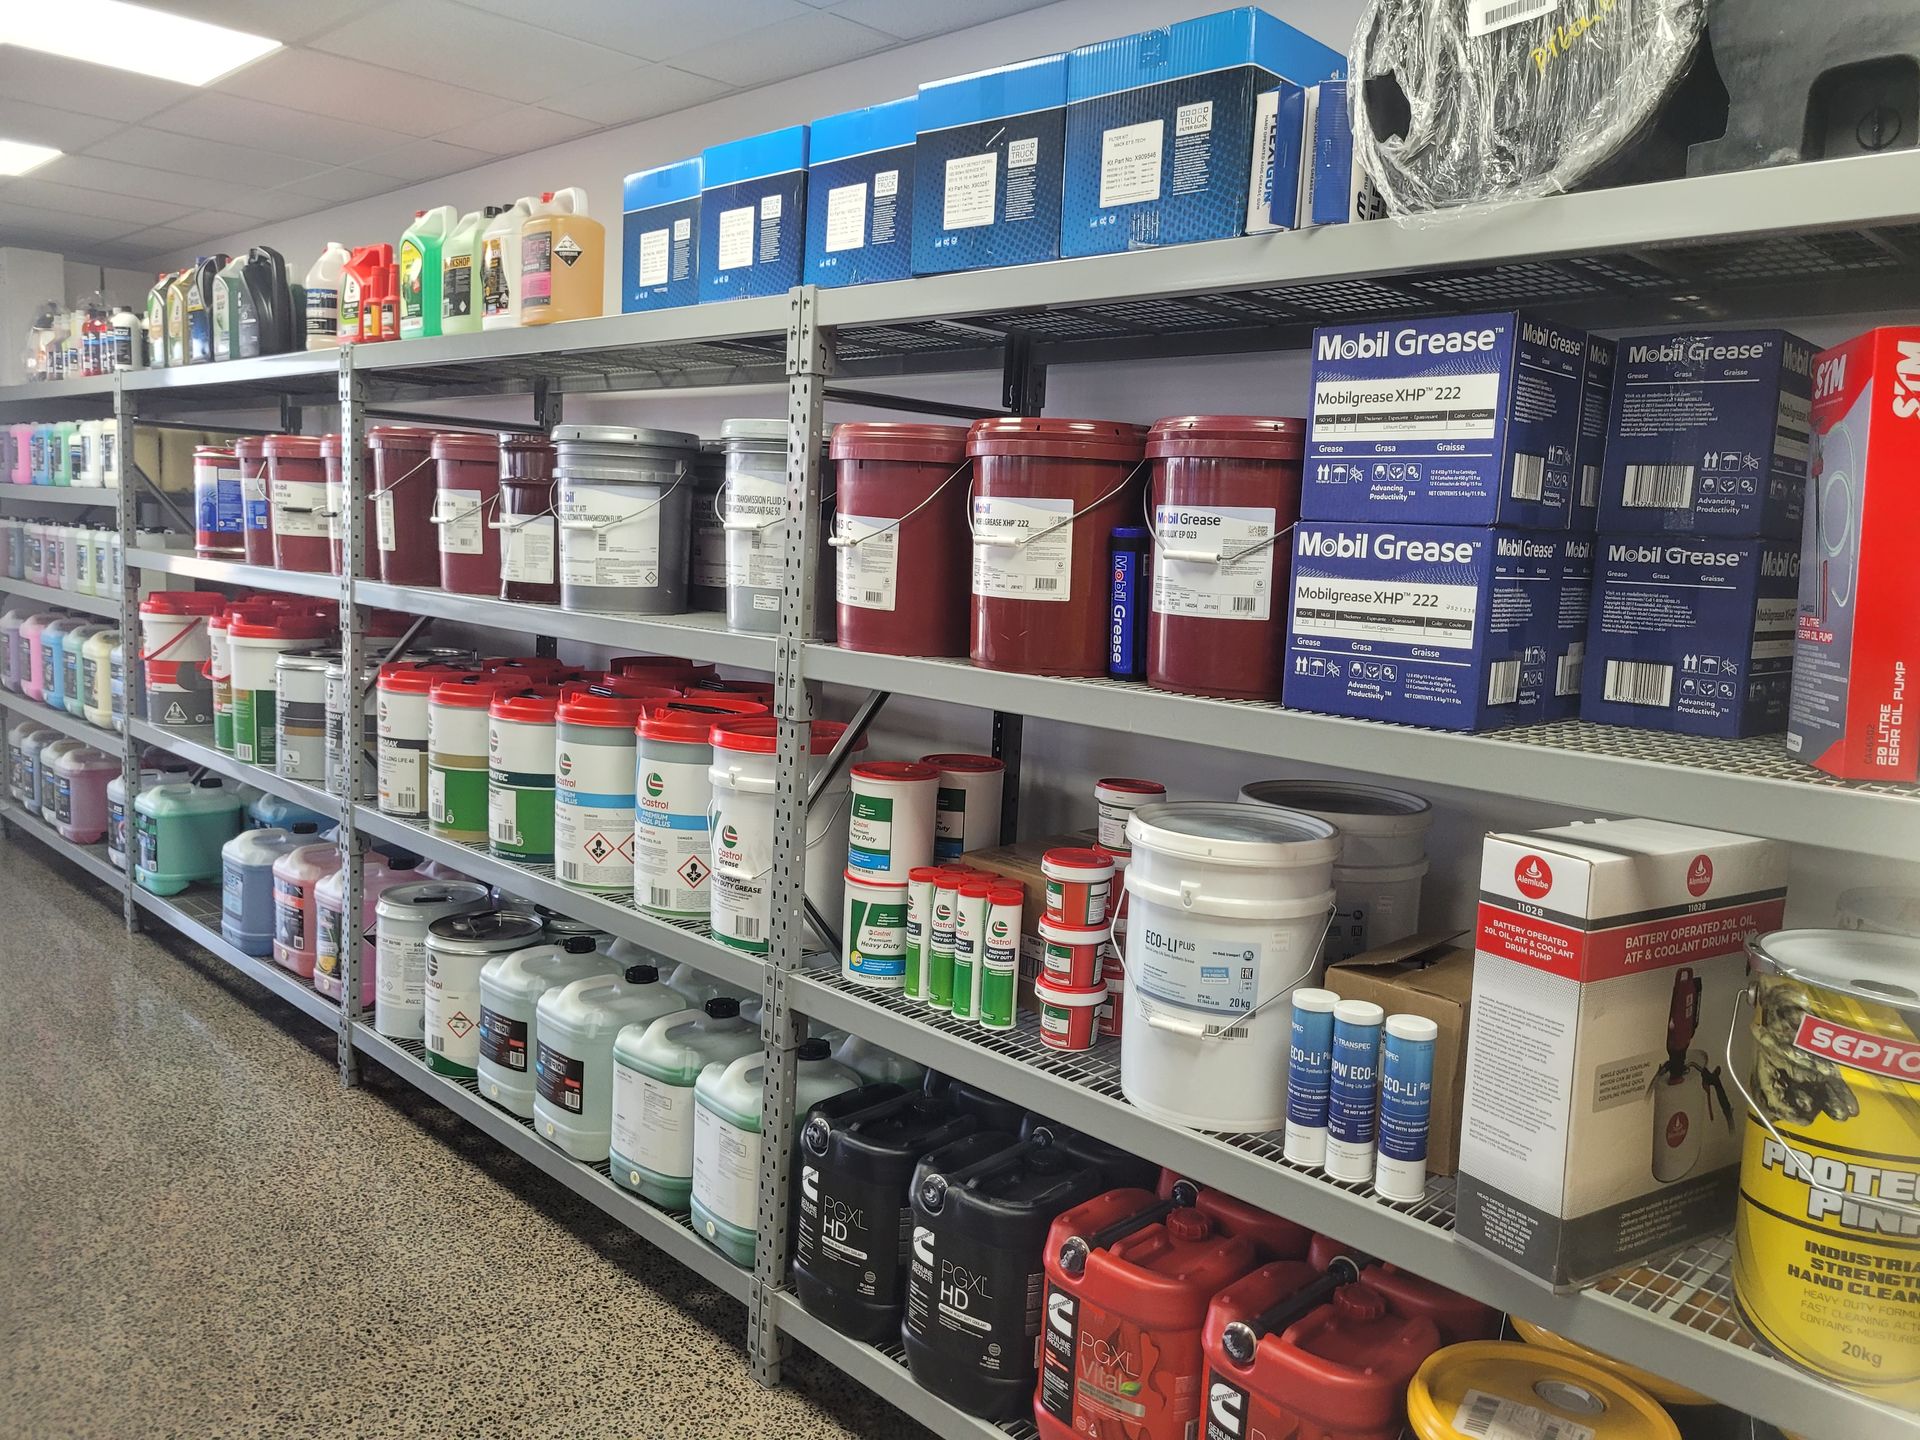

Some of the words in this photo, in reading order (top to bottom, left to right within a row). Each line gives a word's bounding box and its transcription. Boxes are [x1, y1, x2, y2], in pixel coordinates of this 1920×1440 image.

[1180, 115, 1208, 126] TRUCK
[1011, 150, 1034, 159] TRUCK
[1522, 322, 1548, 346] Mobil
[1318, 330, 1389, 361] Mobil
[1628, 345, 1682, 364] Mobil
[1782, 342, 1808, 376] Mobil
[1317, 392, 1394, 407] Mobilgrease
[1435, 386, 1461, 400] 222
[1319, 445, 1343, 453] Grease
[1375, 444, 1396, 452] Grasa
[1437, 443, 1465, 451] Graisse
[767, 496, 781, 505] FLUID
[766, 506, 775, 515] SAE
[1157, 511, 1178, 524] Mobil
[1180, 513, 1221, 526] Grease
[1179, 530, 1186, 539] EP
[1186, 531, 1197, 540] 023
[1298, 531, 1368, 559] Mobil
[1497, 538, 1522, 557] Mobil
[1565, 541, 1589, 558] Mobil
[1608, 545, 1661, 564] Mobil
[1761, 550, 1787, 577] Mobil
[1115, 555, 1127, 602] Mobil
[1298, 586, 1372, 603] Mobilgrease
[1412, 594, 1439, 607] 222
[1806, 618, 1820, 628] LITRE
[1112, 604, 1126, 664] Grease
[1297, 637, 1321, 646] Grease
[1819, 632, 1833, 642] PUMP
[1351, 642, 1372, 652] Grasa
[1412, 647, 1440, 658] Graisse
[1348, 681, 1380, 692] Advancing
[1894, 661, 1905, 700] PUMP
[1679, 698, 1716, 708] Advancing
[1878, 704, 1891, 743] LITRE
[1891, 703, 1903, 726] OIL
[1877, 746, 1887, 766] 20
[1888, 729, 1900, 766] GEAR
[557, 776, 576, 788] Castrol
[642, 797, 669, 810] Castrol
[642, 811, 668, 820] PREMIUM
[655, 820, 671, 828] PLUS
[718, 848, 742, 861] Castrol
[719, 857, 739, 868] Grease
[717, 872, 740, 884] PREMIUM
[720, 880, 734, 890] DUTY
[735, 884, 762, 894] GREASE
[1516, 874, 1549, 890] Alemlube
[1689, 874, 1710, 885] Alemlube
[1517, 902, 1544, 917] 11028
[1688, 903, 1706, 912] 11028
[932, 920, 954, 929] Castrol
[1493, 919, 1526, 935] BATTERY
[1527, 928, 1568, 947] OPERATED
[1625, 930, 1669, 949] BATTERY
[1671, 920, 1720, 941] OPERATED
[1722, 919, 1738, 931] 20L
[1740, 915, 1756, 928] OIL,
[1146, 930, 1177, 953] ECO-LI
[1179, 940, 1196, 951] PLUS
[1484, 926, 1497, 936] 20L
[1498, 928, 1513, 940] OIL,
[1514, 933, 1528, 944] ATF
[1537, 940, 1574, 960] COOLANT
[1624, 951, 1643, 965] ATF
[1645, 950, 1652, 960] &
[1654, 939, 1700, 959] COOLANT
[1701, 933, 1729, 949] DRUM
[1505, 942, 1527, 954] DRUM
[1529, 948, 1552, 961] PUMP
[1230, 998, 1239, 1007] 20
[1241, 1001, 1250, 1010] kg
[1338, 1038, 1370, 1049] TRANSPEC
[1290, 1045, 1320, 1066] ECO-Li
[1630, 1062, 1650, 1072] COUPLING
[1384, 1074, 1417, 1096] ECO-Li
[1333, 1126, 1345, 1135] gram
[824, 1195, 868, 1230] PGXL
[823, 1215, 847, 1242] HD
[913, 1232, 933, 1242] Cummins
[912, 1260, 933, 1276] GENUINE
[912, 1265, 933, 1284] PRODUCTS
[1788, 1264, 1843, 1291] HAND
[941, 1259, 993, 1299] PGXL
[940, 1281, 968, 1310] HD
[1049, 1299, 1071, 1310] Cummins
[1804, 1288, 1838, 1304] HEAVY
[1843, 1299, 1875, 1312] DUTY
[1800, 1312, 1852, 1334] CONTAINS
[1801, 1300, 1827, 1314] FAST
[1832, 1309, 1888, 1328] CLEANING
[1047, 1328, 1071, 1349] GENUINE
[1047, 1335, 1070, 1356] PRODUCTS
[1080, 1330, 1140, 1377] PGXL
[1842, 1340, 1882, 1368] 20kg
[1081, 1358, 1123, 1394] Vital
[1211, 1391, 1238, 1401] Cummins
